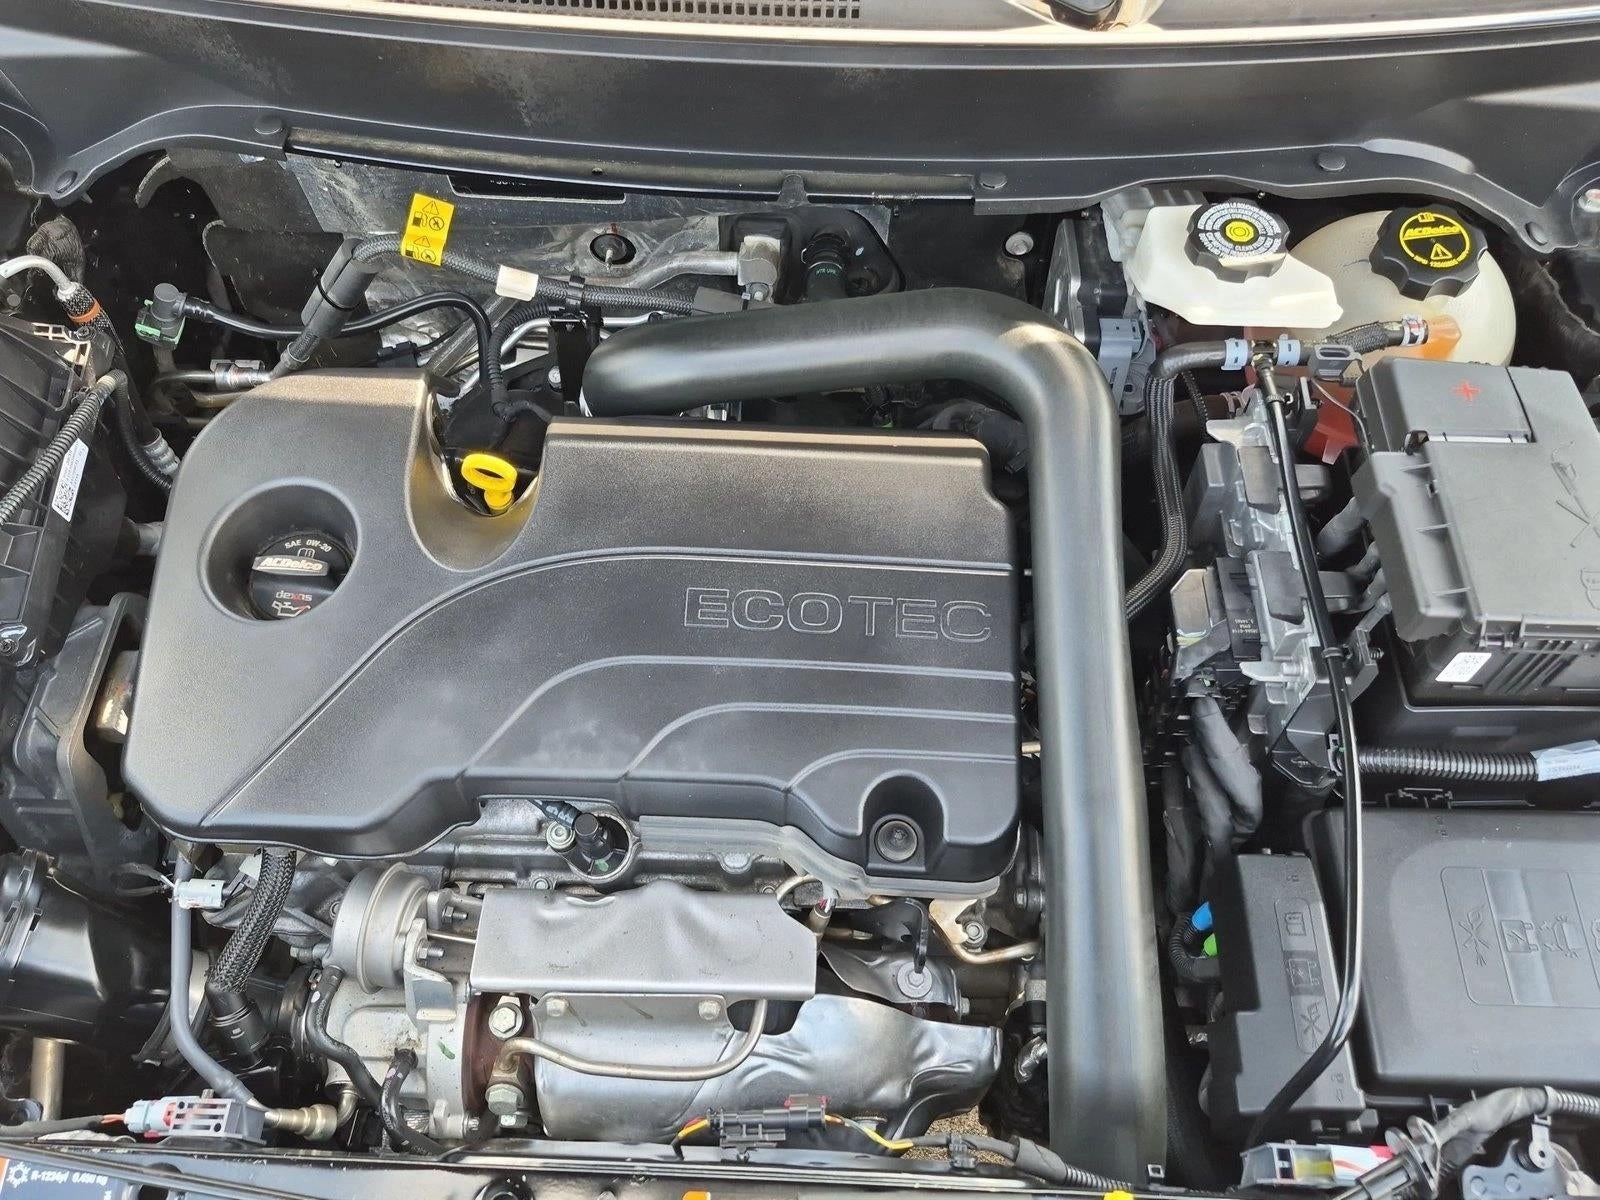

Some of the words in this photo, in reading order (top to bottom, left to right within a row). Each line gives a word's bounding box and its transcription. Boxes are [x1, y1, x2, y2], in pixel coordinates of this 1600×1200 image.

[284, 539, 302, 549] SAE
[259, 557, 323, 571] ACDelco
[684, 586, 992, 643] ECOTEC
